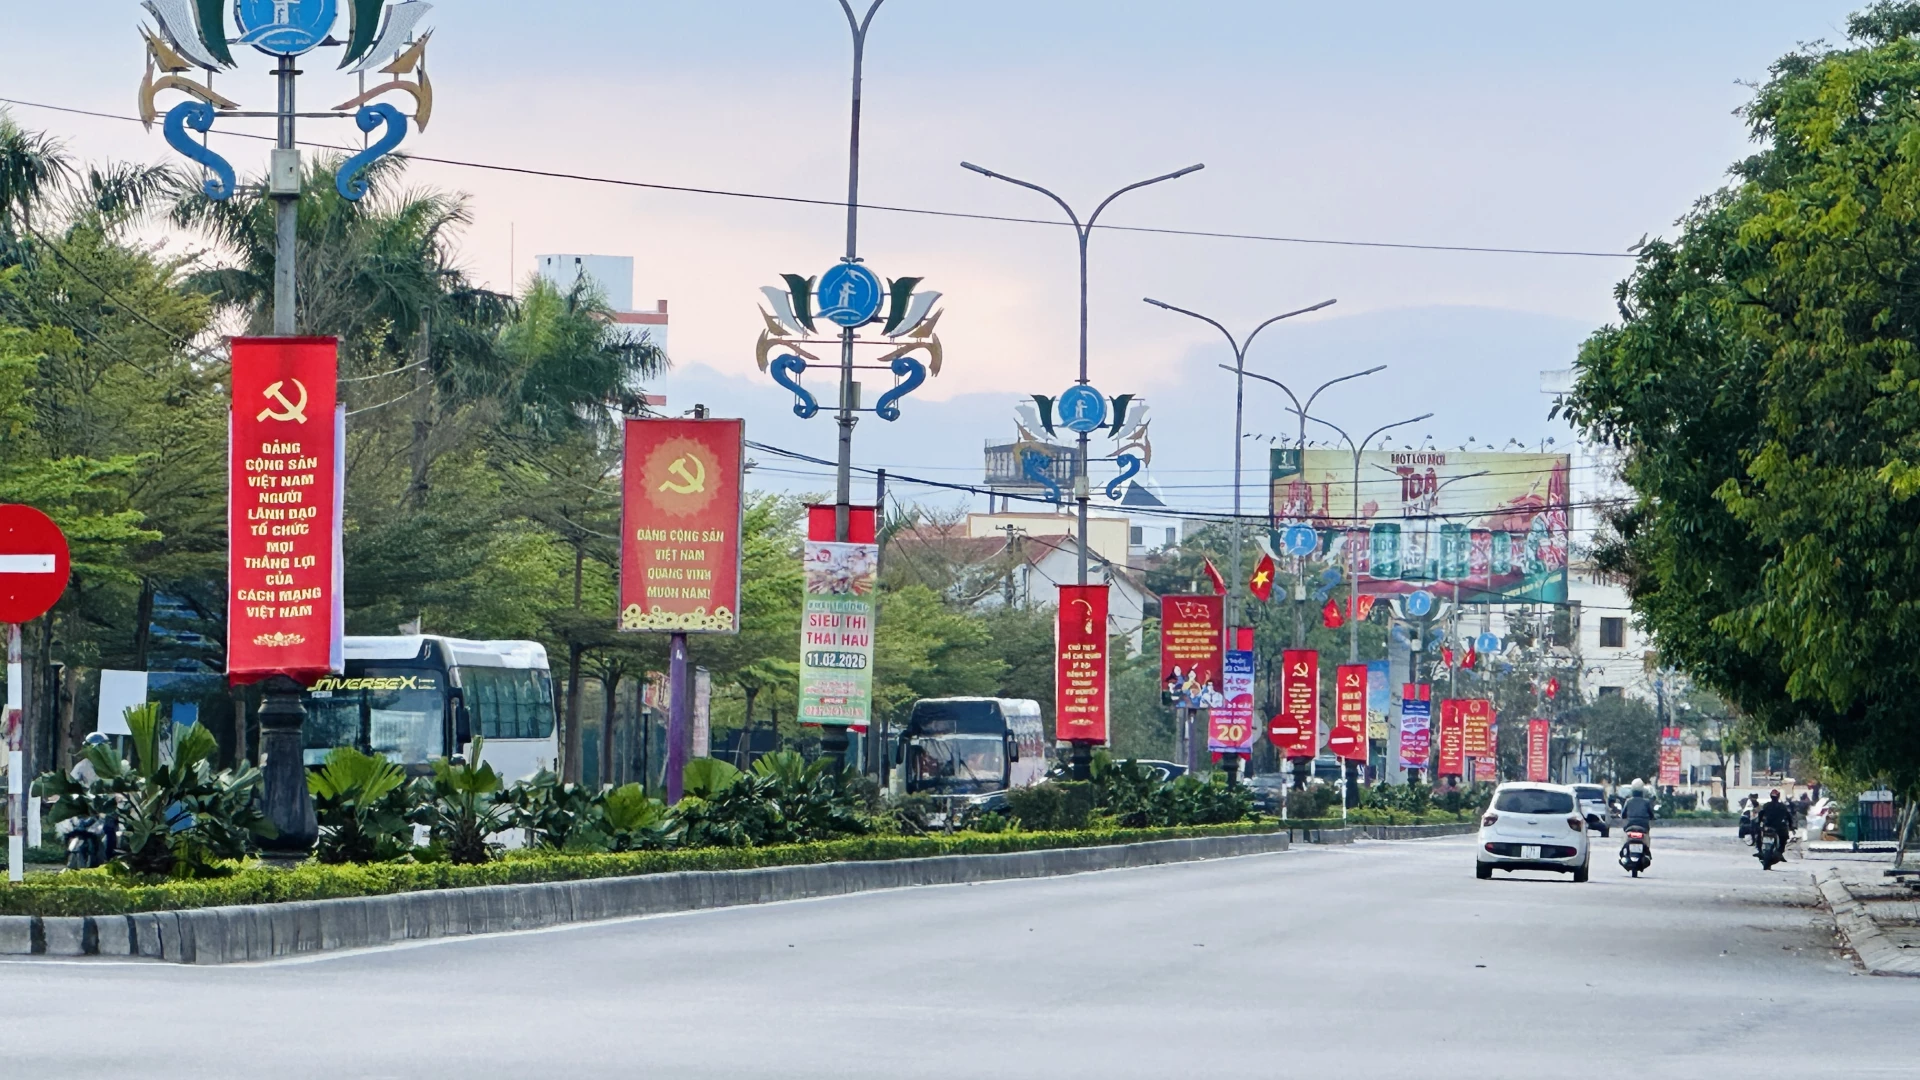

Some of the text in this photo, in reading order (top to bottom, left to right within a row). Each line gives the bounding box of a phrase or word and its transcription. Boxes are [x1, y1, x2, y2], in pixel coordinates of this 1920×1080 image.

[245, 455, 318, 473] CỘNG SẢN
[248, 474, 314, 489] VIỆT NAM
[259, 489, 302, 503] NGƯỜI
[272, 522, 309, 536] CHỨC
[266, 541, 294, 554] MỌI
[294, 555, 315, 569] LỢI
[680, 549, 705, 561] NAM
[265, 570, 294, 586] CỦA
[237, 587, 321, 603] CÁCH MẠNG
[246, 605, 312, 619] VIỆT NAM
[807, 652, 866, 669] 11.02.2026
